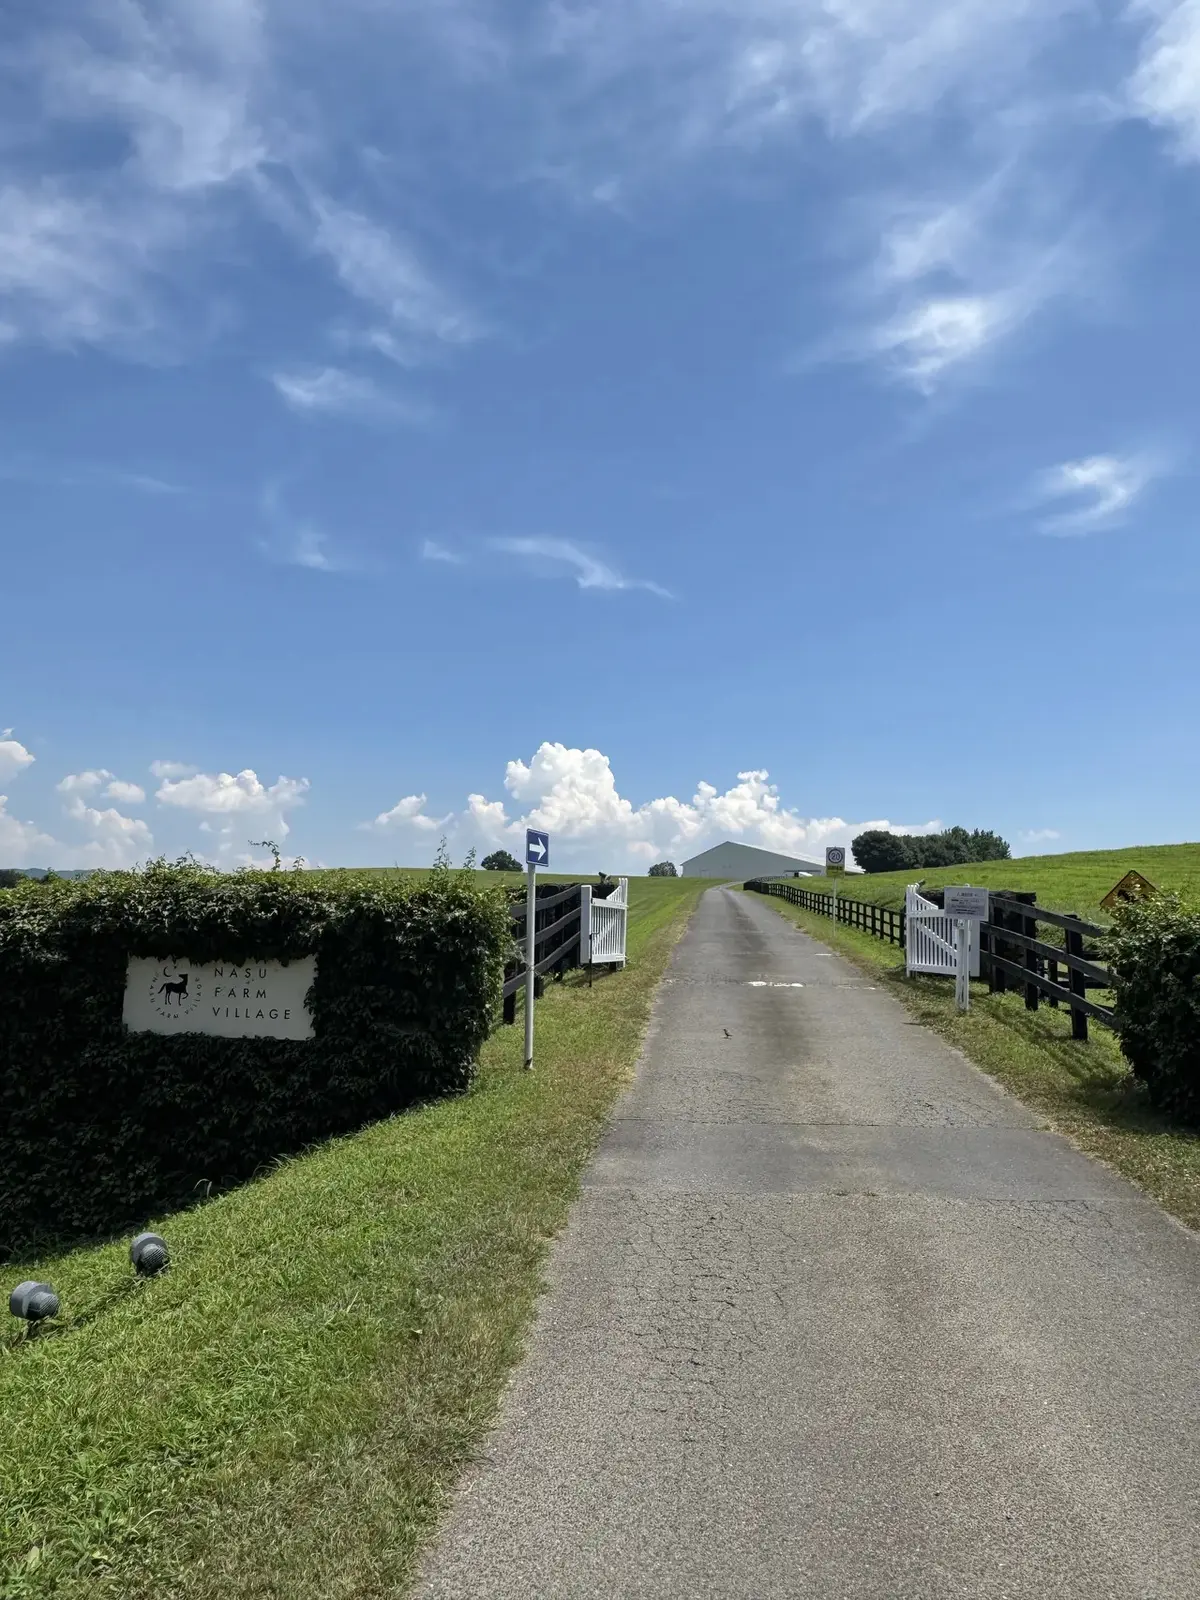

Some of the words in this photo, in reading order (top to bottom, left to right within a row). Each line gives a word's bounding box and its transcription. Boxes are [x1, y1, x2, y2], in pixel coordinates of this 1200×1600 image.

[214, 967, 267, 979] NASU
[214, 986, 267, 999] FARM
[212, 1006, 291, 1020] VILLAGE
